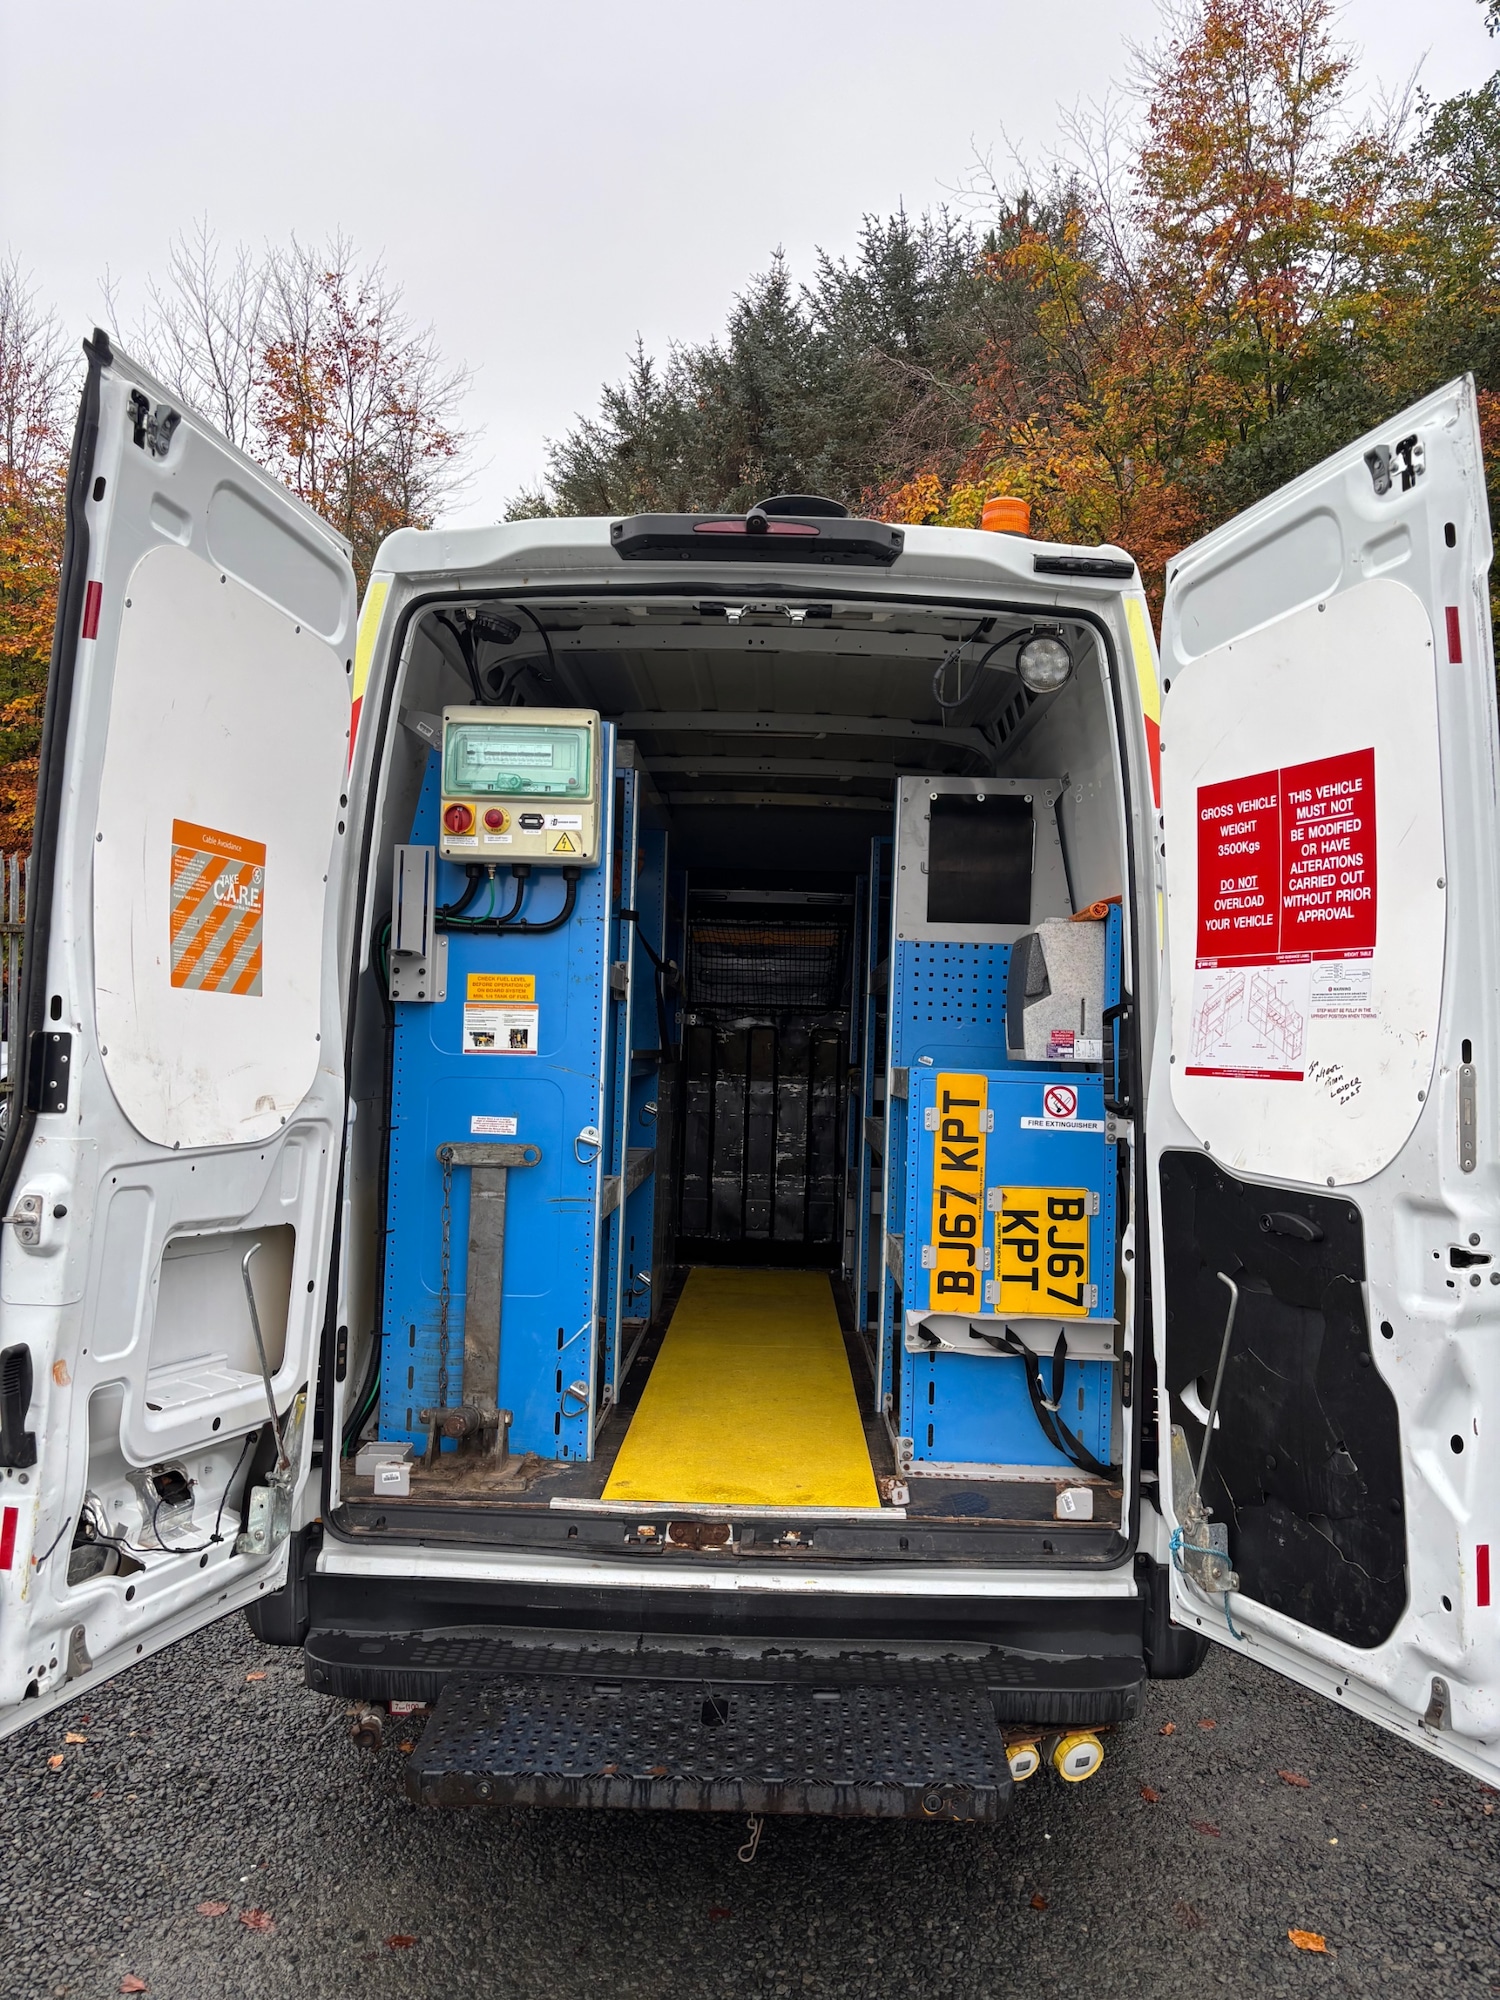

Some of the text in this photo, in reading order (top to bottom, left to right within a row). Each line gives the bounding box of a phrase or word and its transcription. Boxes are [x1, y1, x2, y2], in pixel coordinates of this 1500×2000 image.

[1288, 779, 1362, 804] THIS VEHICLE
[1201, 795, 1277, 820] GROSS VEHICLE
[1297, 798, 1353, 819] MUST NOT
[1220, 820, 1257, 837] WEIGHT
[1290, 819, 1361, 842] BE MODIFIED
[202, 835, 242, 852] Cable Avoidance
[1218, 841, 1260, 856] 3500Kgs
[1301, 838, 1350, 856] OR HAVE
[1290, 853, 1363, 874] ALTERATIONS
[220, 874, 239, 885] TAKE
[1221, 876, 1258, 891] DO NOT
[1289, 870, 1364, 891] CARRIED OUT
[1214, 895, 1264, 911] OVERLOAD
[1284, 887, 1371, 908] WITHOUT PRIOR
[1206, 914, 1273, 931] YOUR VEHICLE
[1297, 907, 1354, 923] APPROVAL
[1045, 1121, 1097, 1129] EXTINGUISHER
[937, 1090, 980, 1296] BJ67 KPT
[1002, 1210, 1039, 1291] KPT
[1047, 1196, 1085, 1307] BJ67
